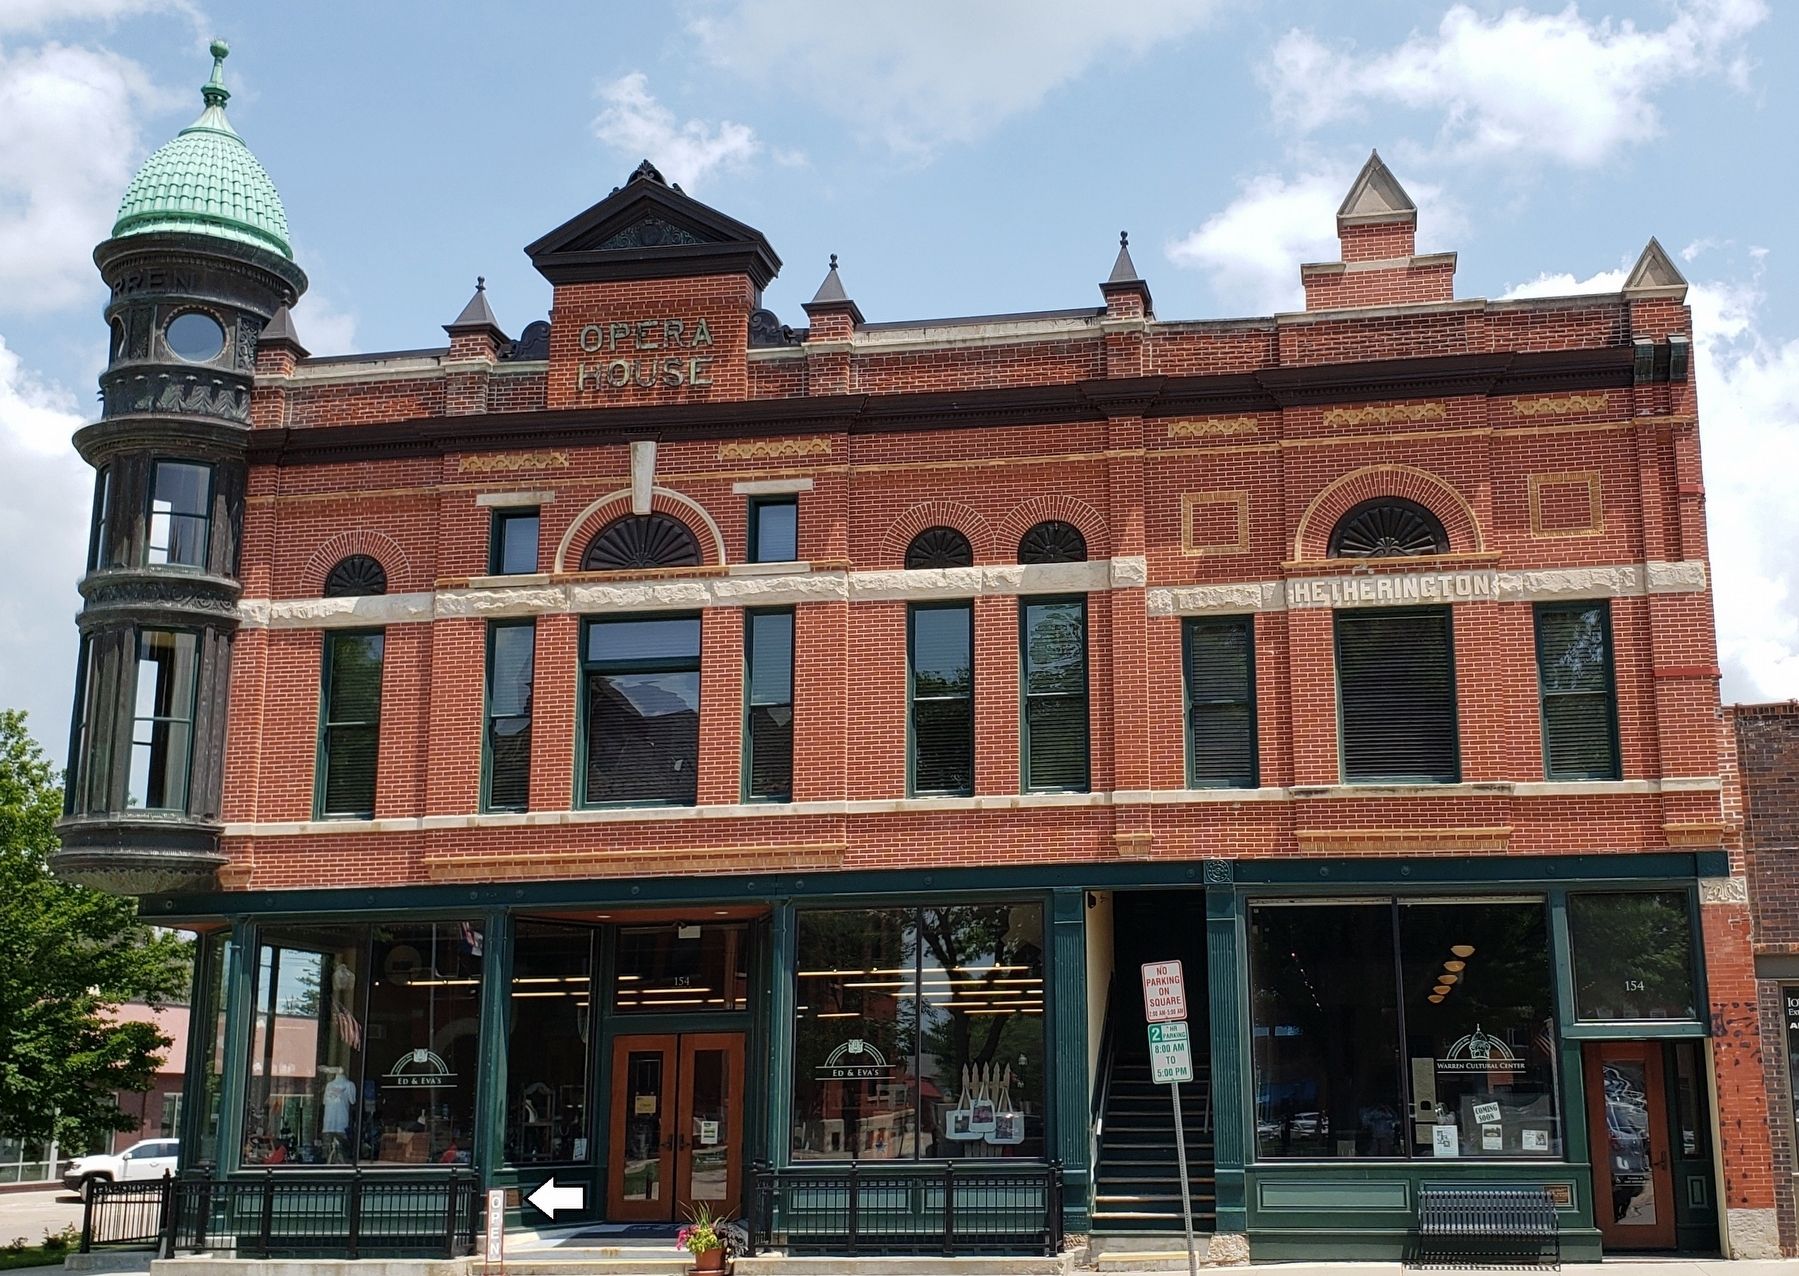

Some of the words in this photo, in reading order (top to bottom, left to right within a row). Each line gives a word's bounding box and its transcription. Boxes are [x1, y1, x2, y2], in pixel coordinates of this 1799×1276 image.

[580, 318, 713, 352] OPERA
[577, 357, 714, 391] HOUSE
[1293, 575, 1490, 603] HETHERINGTON
[1156, 967, 1168, 976] NO
[674, 976, 690, 986] 154
[1146, 975, 1180, 987] PARKING
[1625, 980, 1645, 991] 154
[1158, 987, 1170, 996] ON
[1149, 996, 1182, 1008] SQUARE
[1151, 1027, 1161, 1041] 2
[1154, 1044, 1171, 1054] 8:00
[1172, 1043, 1185, 1052] AM
[1165, 1055, 1176, 1064] TO
[1500, 1061, 1526, 1069] CENTER
[832, 1069, 844, 1077] ED
[847, 1069, 854, 1077] &
[1157, 1068, 1174, 1078] 5:00
[1175, 1066, 1188, 1076] PM
[411, 1077, 418, 1085] &
[1475, 1104, 1498, 1115] COMING
[1478, 1112, 1495, 1122] SOON
[491, 1196, 501, 1255] OPEN
